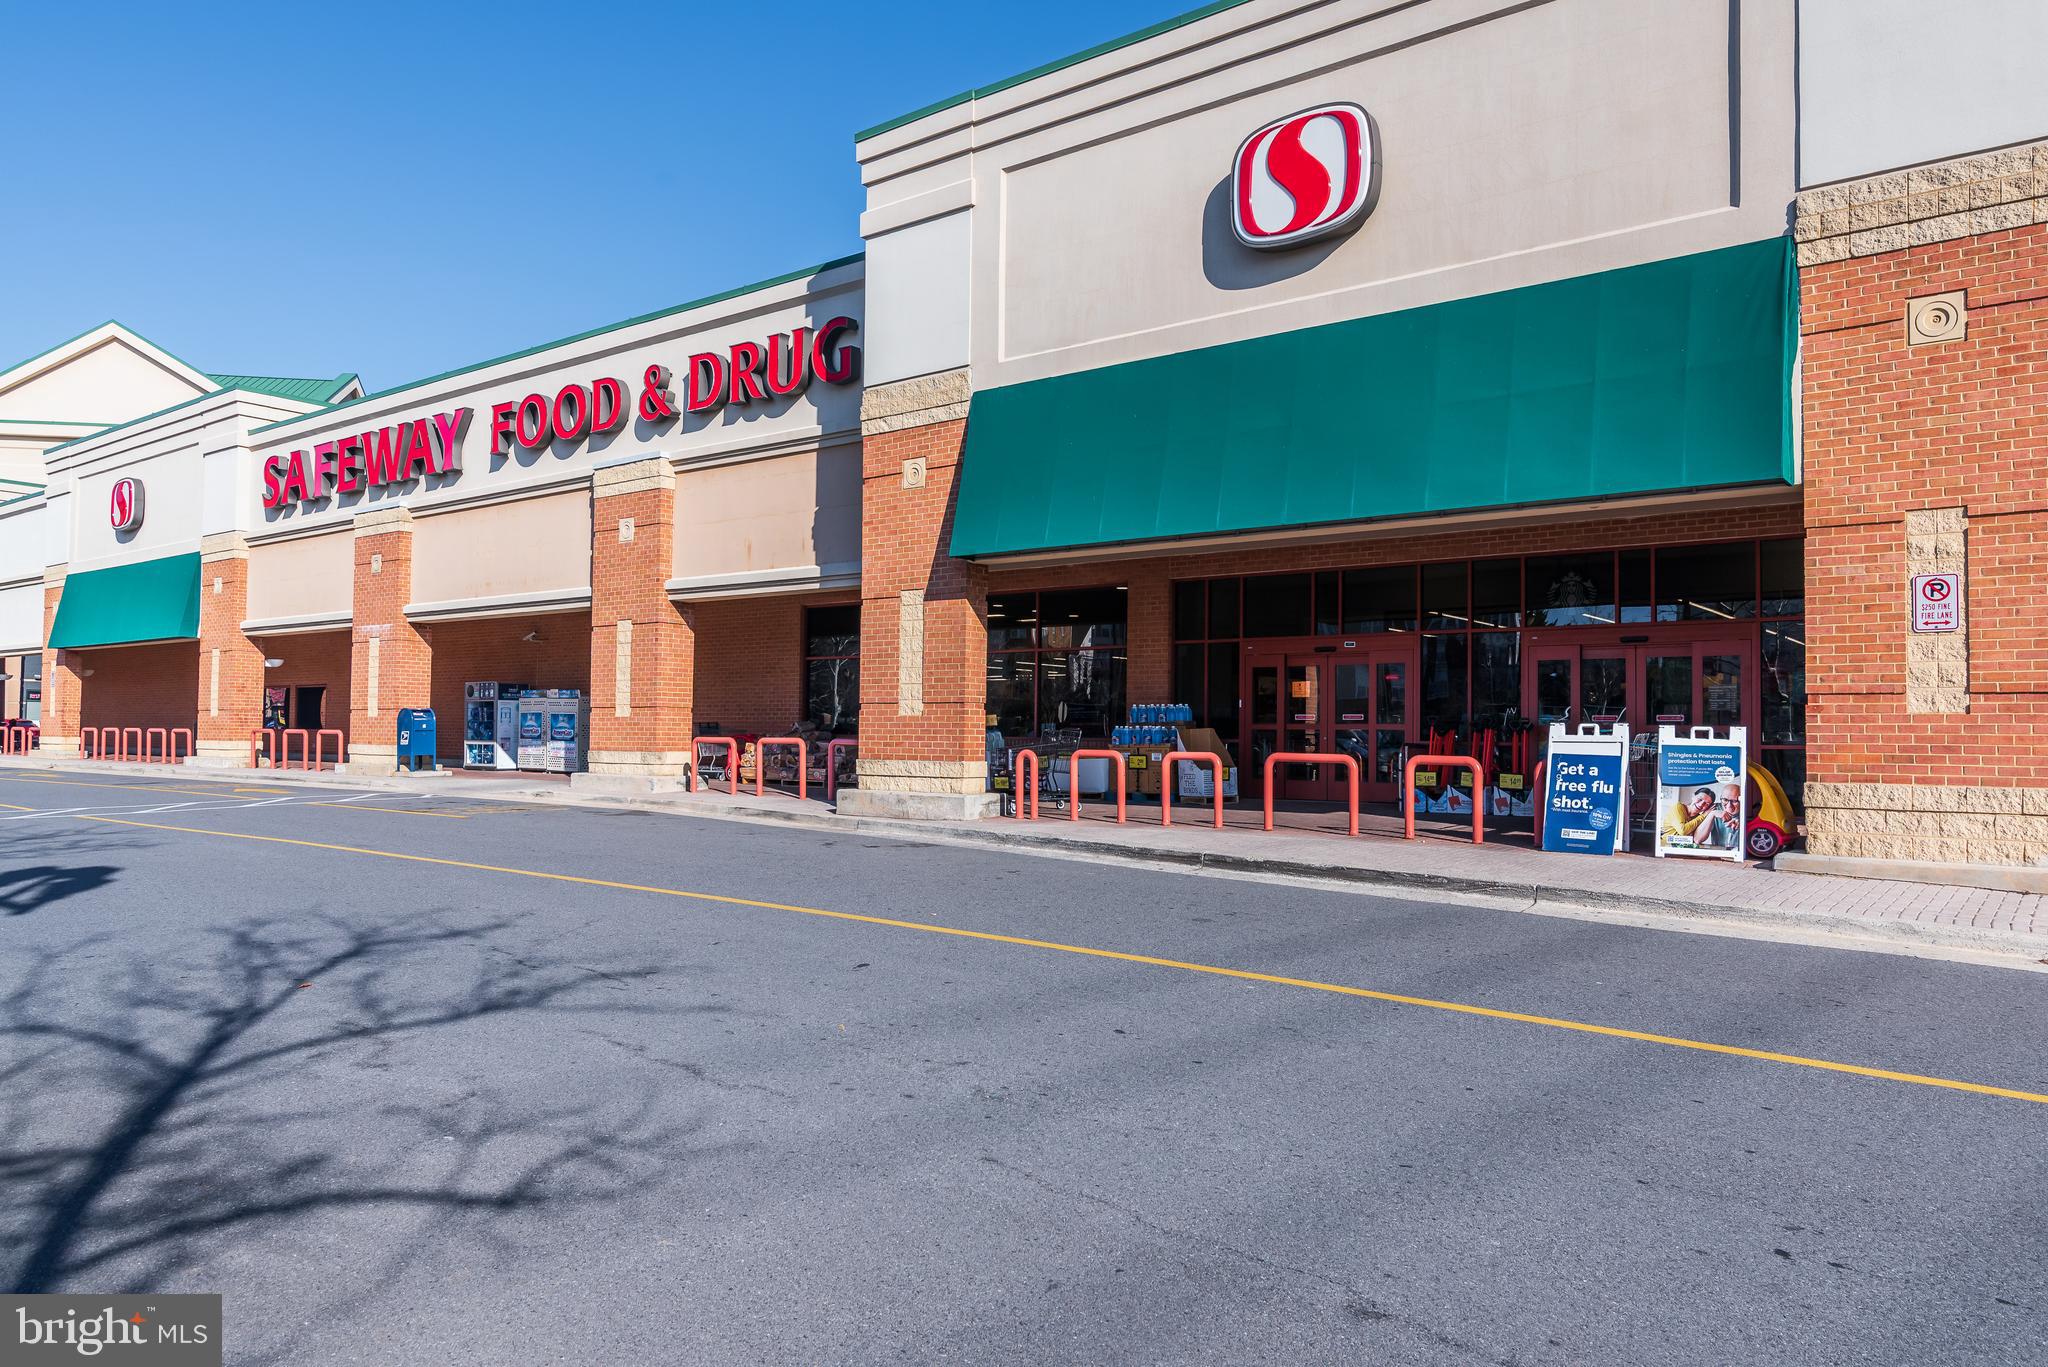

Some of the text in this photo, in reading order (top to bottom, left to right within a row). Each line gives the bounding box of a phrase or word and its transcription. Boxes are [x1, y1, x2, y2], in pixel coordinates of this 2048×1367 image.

[262, 316, 861, 509] SAFEWAY FOOD & DRUG
[1937, 611, 1953, 619] LANE
[1557, 762, 1599, 776] Get a
[1555, 779, 1614, 794] free flu
